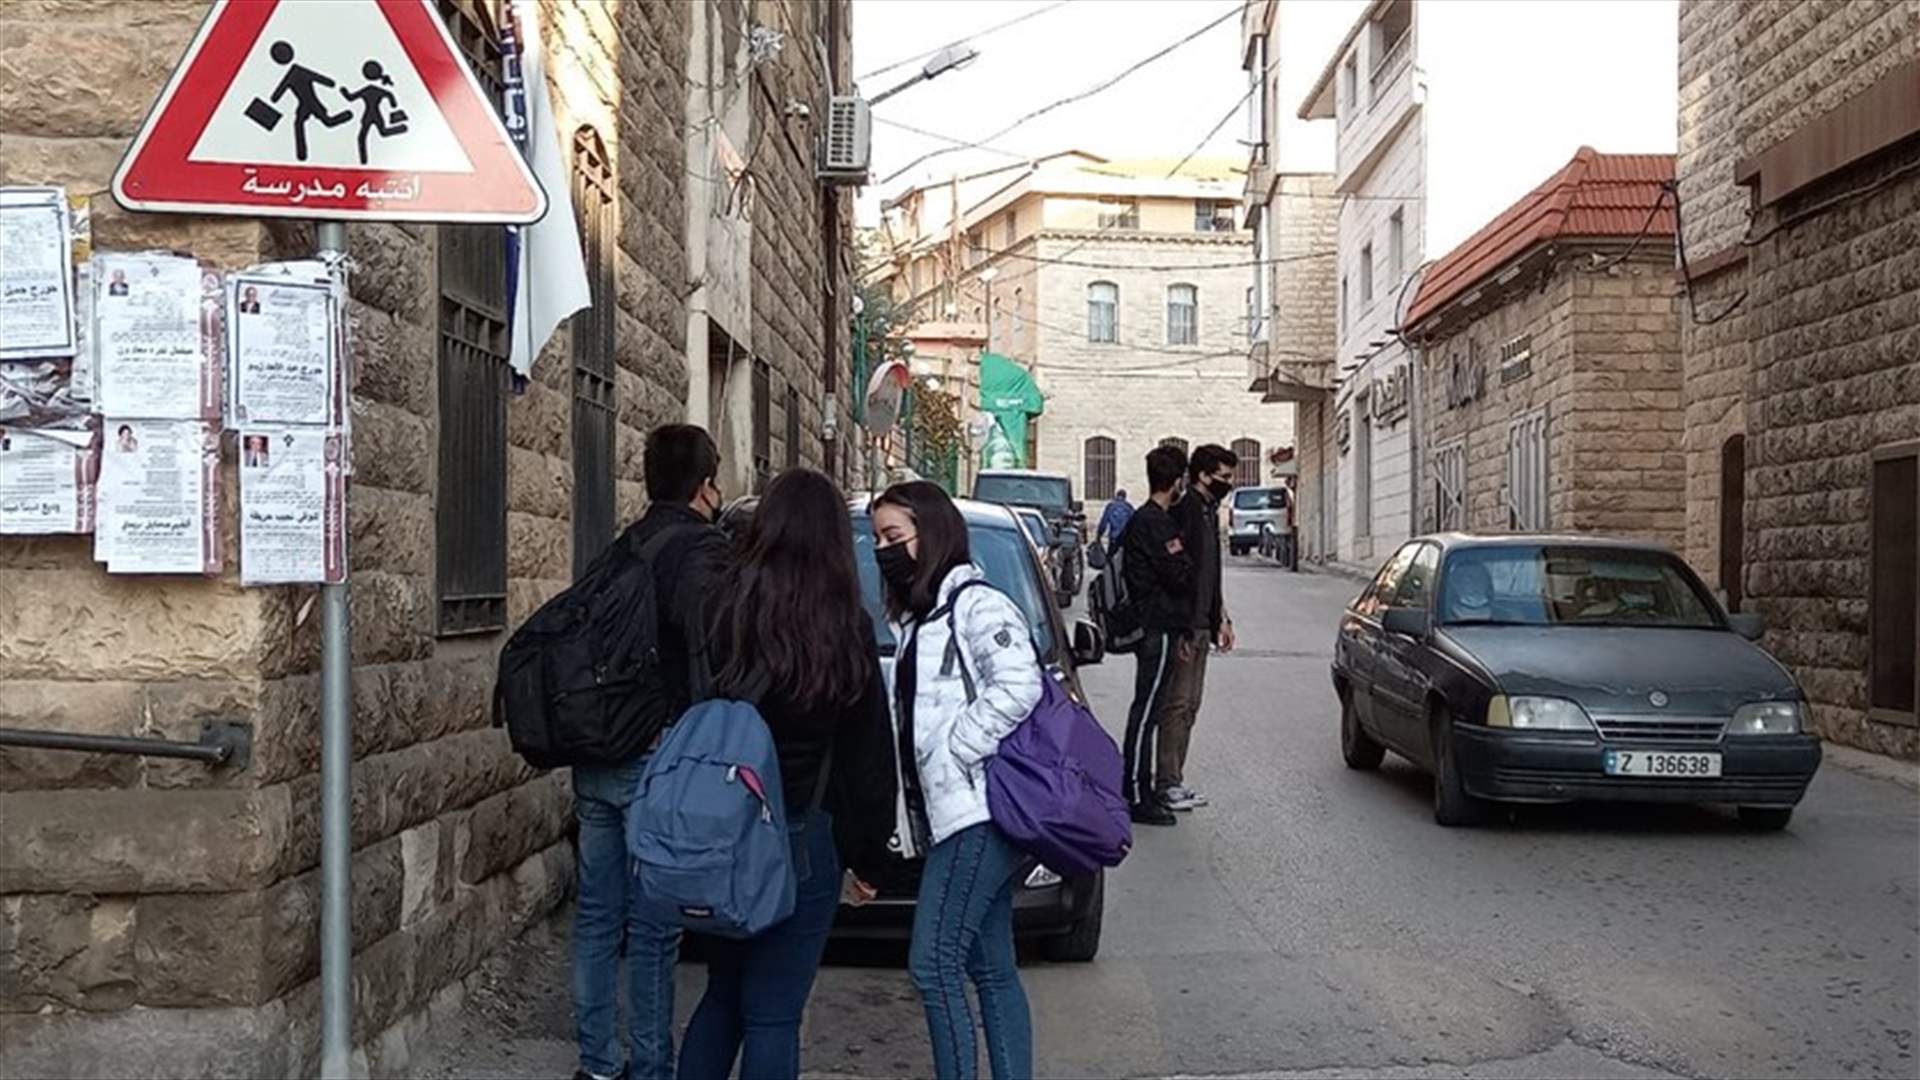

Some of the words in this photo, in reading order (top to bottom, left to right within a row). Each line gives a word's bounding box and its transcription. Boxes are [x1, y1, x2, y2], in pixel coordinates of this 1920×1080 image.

[242, 168, 346, 203] مدرسة
[355, 174, 420, 206] انتبه
[1620, 753, 1633, 773] Z
[1645, 754, 1710, 775] 136638
